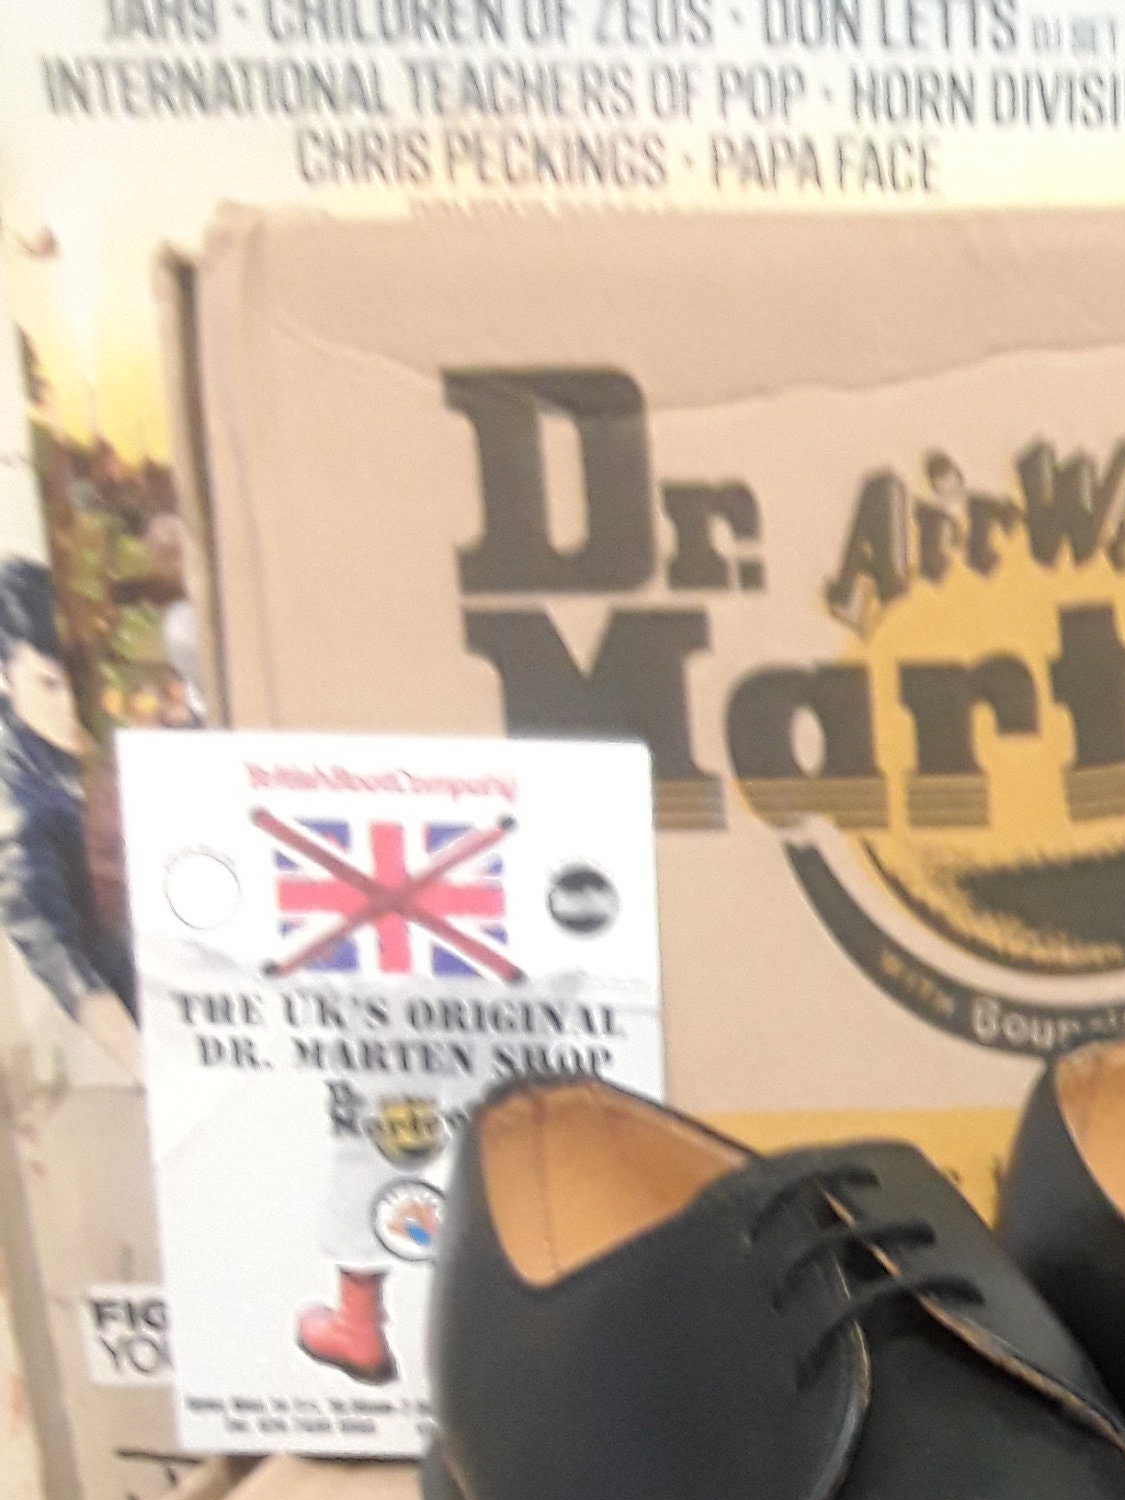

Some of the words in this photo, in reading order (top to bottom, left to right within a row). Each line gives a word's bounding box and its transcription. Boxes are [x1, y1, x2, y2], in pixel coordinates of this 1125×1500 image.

[264, 0, 508, 46] CHILDREN
[523, 0, 572, 44] OF
[594, 0, 714, 48] ZEUS
[764, 0, 860, 50] DON
[880, 0, 1018, 53] LETTS
[41, 54, 392, 117] INTERNATIONAL
[404, 57, 636, 118] TEACHERS
[650, 60, 700, 120] OF
[717, 62, 807, 123] POP
[850, 66, 977, 128] HORN
[298, 125, 436, 187] CHRIS
[445, 129, 669, 191] PECKINGS
[711, 135, 824, 194] PAPA
[836, 137, 941, 196] FACE
[440, 364, 765, 594] Dr.
[174, 990, 263, 1027] THE
[283, 992, 391, 1031] UK'S
[404, 995, 627, 1038] ORIGINAL
[197, 1034, 274, 1071] DR.
[290, 1037, 475, 1077] MARTEN
[493, 1046, 613, 1079] SHOP
[98, 1333, 174, 1376] YO
